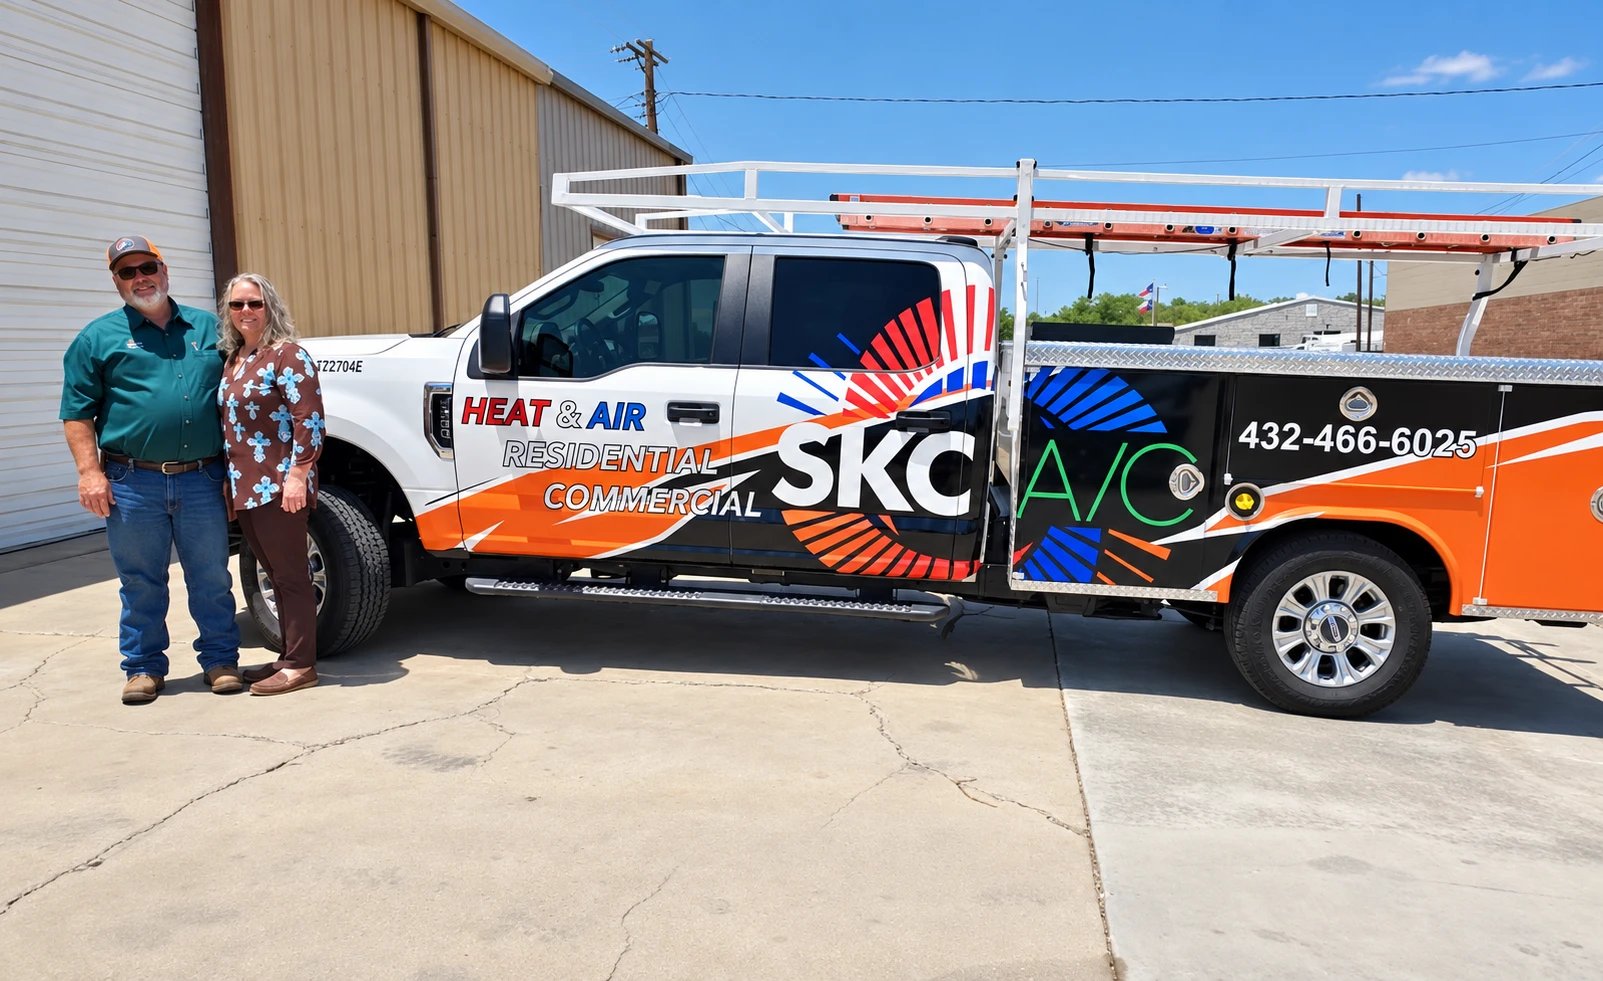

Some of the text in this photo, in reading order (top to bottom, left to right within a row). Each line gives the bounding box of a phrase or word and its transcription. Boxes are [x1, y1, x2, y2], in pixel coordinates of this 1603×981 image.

[461, 397, 552, 427] HEAT
[556, 400, 582, 429] &
[586, 401, 647, 431] AIR
[502, 440, 717, 475] RESIDENTIAL
[1238, 421, 1477, 459] 432-466-6025
[772, 423, 976, 517] SKC
[1016, 439, 1197, 527] A/C
[544, 483, 761, 517] COMMERCIAL
